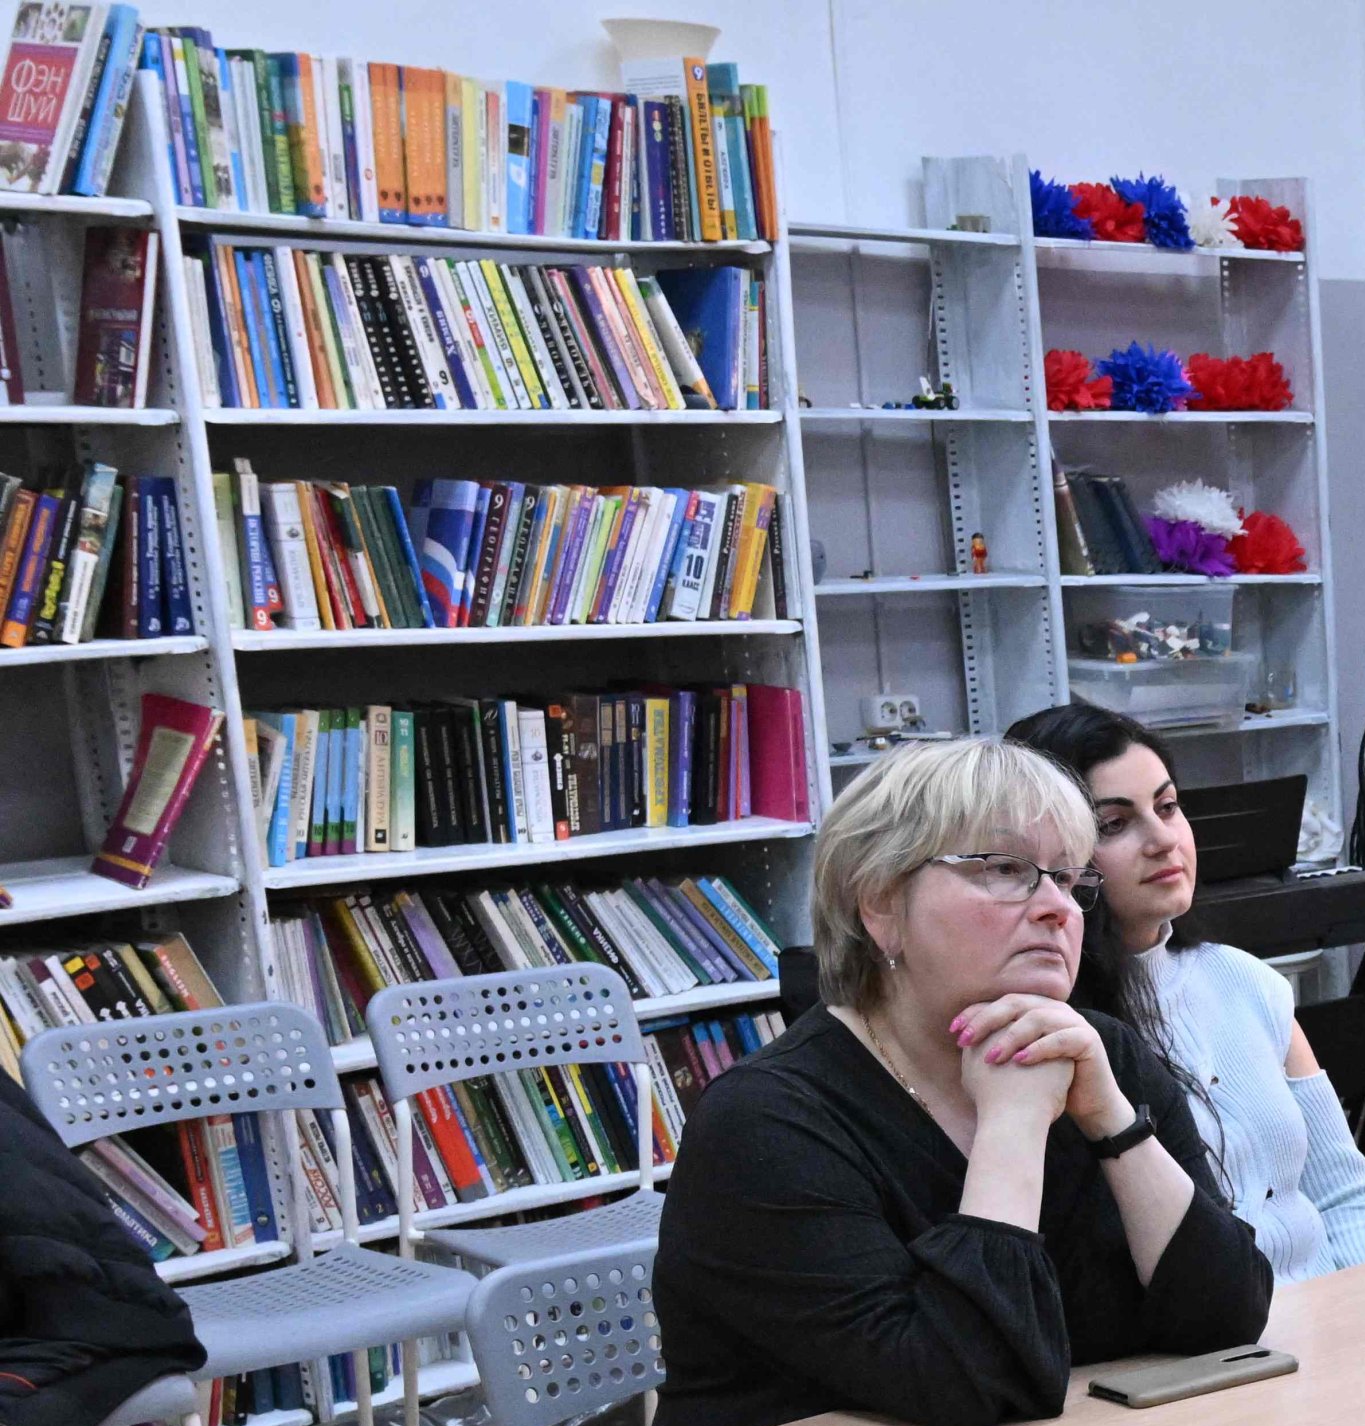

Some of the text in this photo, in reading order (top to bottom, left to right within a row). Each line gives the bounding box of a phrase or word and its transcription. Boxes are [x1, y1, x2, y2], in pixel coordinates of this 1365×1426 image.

[11, 59, 65, 95] ФЭН
[693, 65, 703, 79] 9
[8, 93, 56, 122] ШУЙ
[696, 93, 710, 147] БИЛЕТЫ
[703, 159, 716, 211] ОТВЕТЫ
[486, 305, 508, 351] ХИМИЯ
[439, 370, 449, 386] 9
[478, 494, 504, 604] 9 ГЕОГРАФИЯ
[508, 495, 536, 604] 9 ГЕОГРАФИЯ
[685, 554, 705, 580] 10
[268, 588, 278, 603] 9
[682, 578, 700, 591] КЛАСС
[256, 609, 267, 626] 9
[653, 709, 665, 806] ХРЕСТОМАТИЯ
[592, 926, 619, 964] ФИЗИКА
[104, 1193, 158, 1248] тематика
